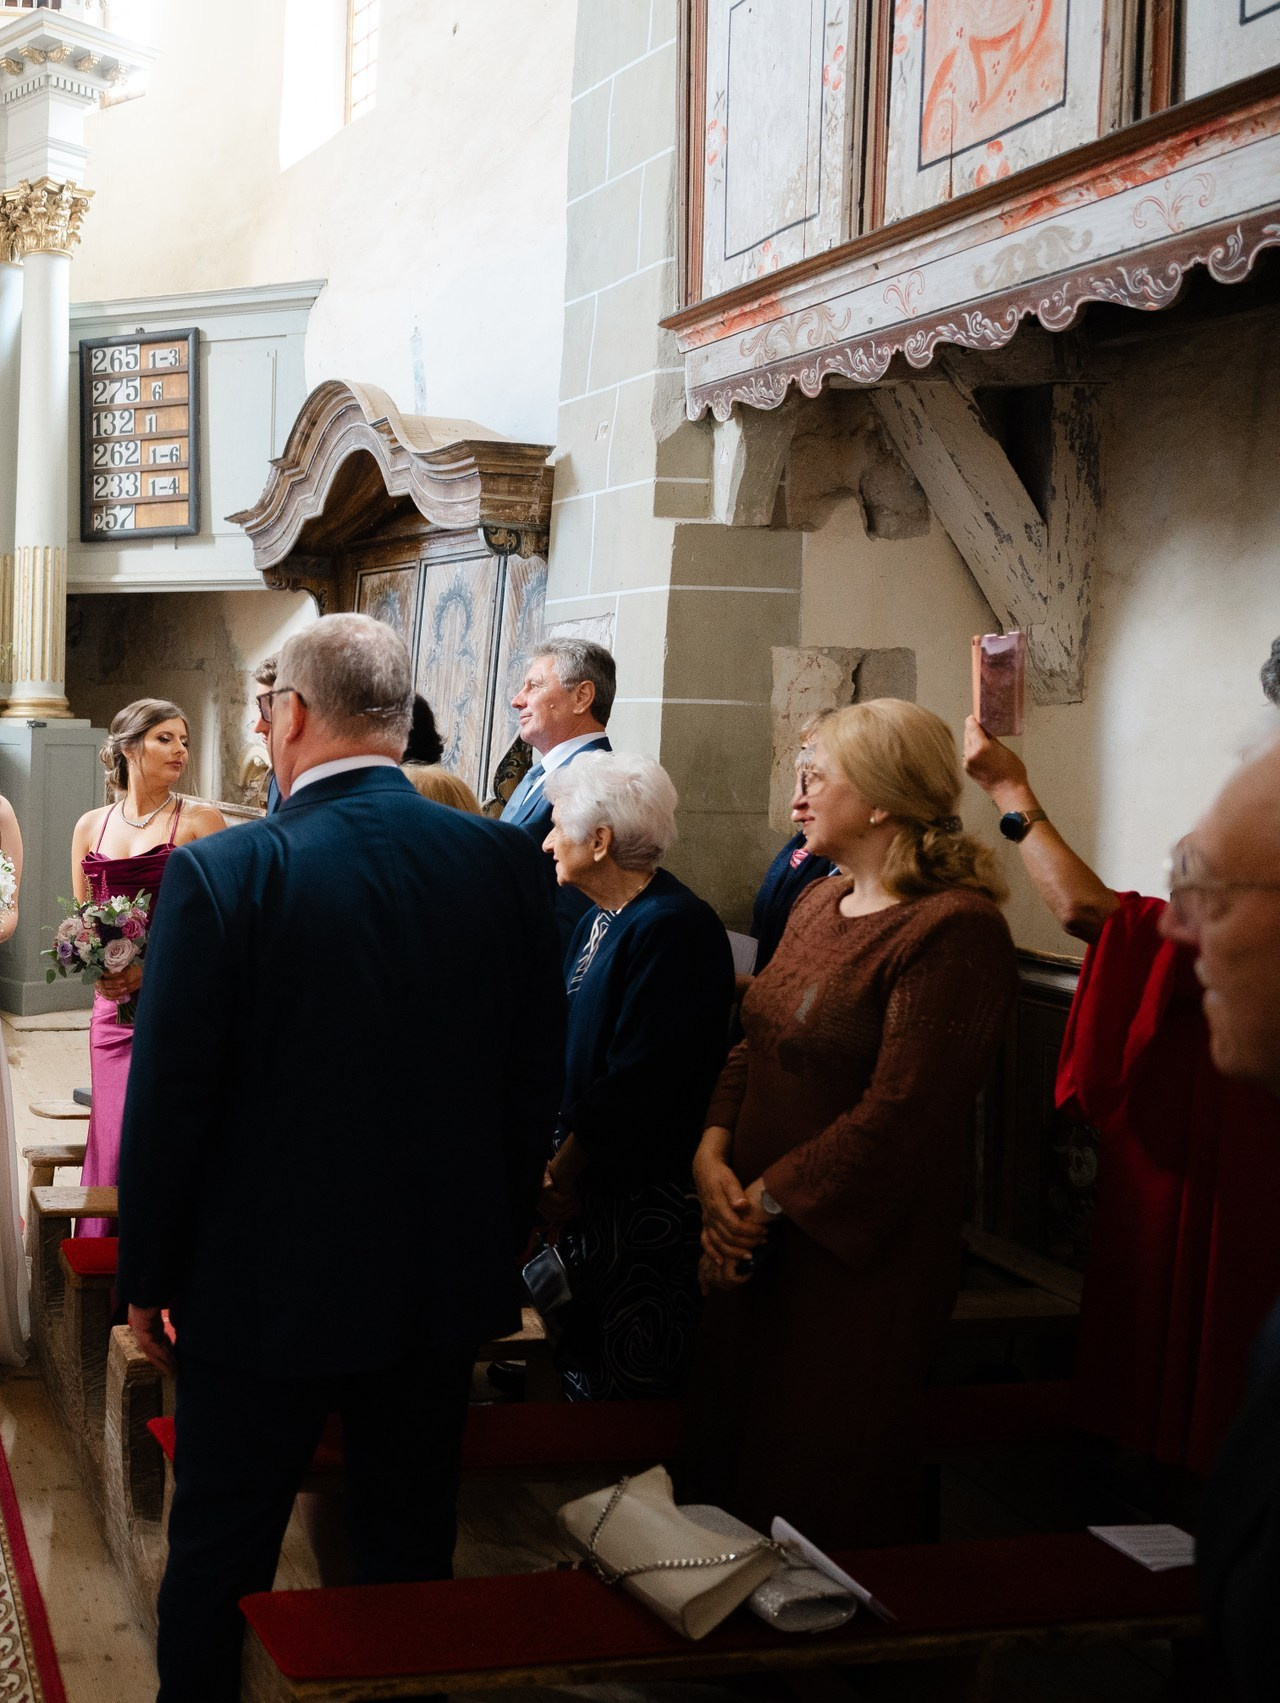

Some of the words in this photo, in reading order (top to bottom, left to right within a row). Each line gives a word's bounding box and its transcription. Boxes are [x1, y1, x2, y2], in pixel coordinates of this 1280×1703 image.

[93, 346, 138, 373] 265
[150, 349, 178, 368] 1-3
[94, 377, 138, 404] 275
[152, 384, 161, 400] 6
[94, 409, 133, 436] 132
[148, 415, 155, 433] 1
[95, 441, 139, 467] 262
[152, 447, 179, 464] 1-6
[95, 473, 139, 498] 233
[151, 478, 178, 496] 1-4
[96, 506, 133, 530] 257
